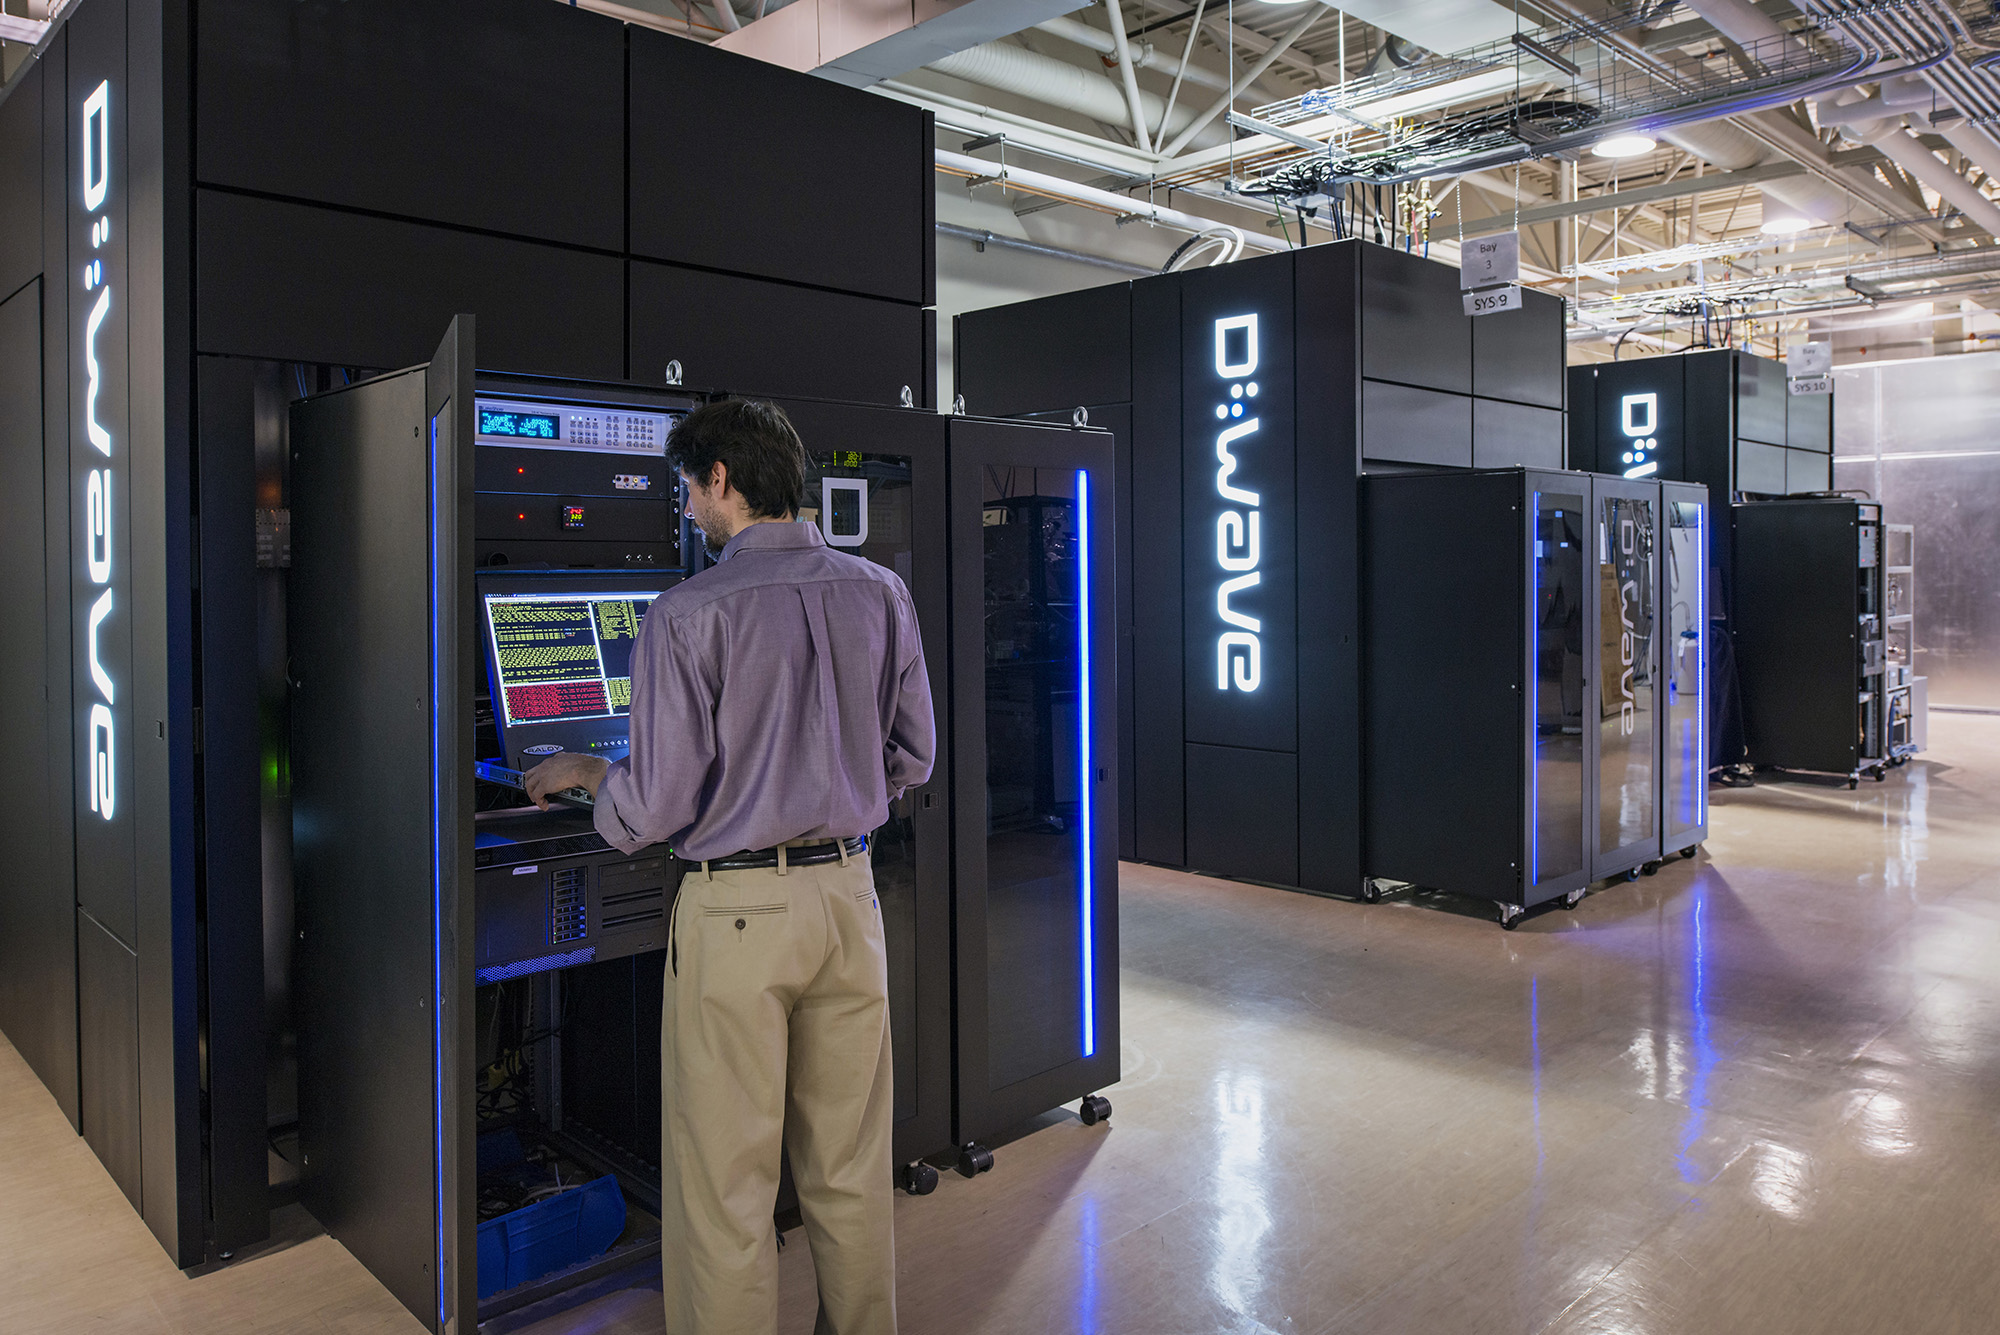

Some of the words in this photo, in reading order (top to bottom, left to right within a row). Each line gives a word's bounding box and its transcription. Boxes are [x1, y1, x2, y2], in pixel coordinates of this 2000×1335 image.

[1480, 243, 1497, 253] Bay
[1486, 260, 1492, 269] 3
[1475, 296, 1495, 310] SYS
[1499, 294, 1507, 306] 9
[1795, 383, 1811, 393] SYS
[1814, 382, 1826, 391] 10
